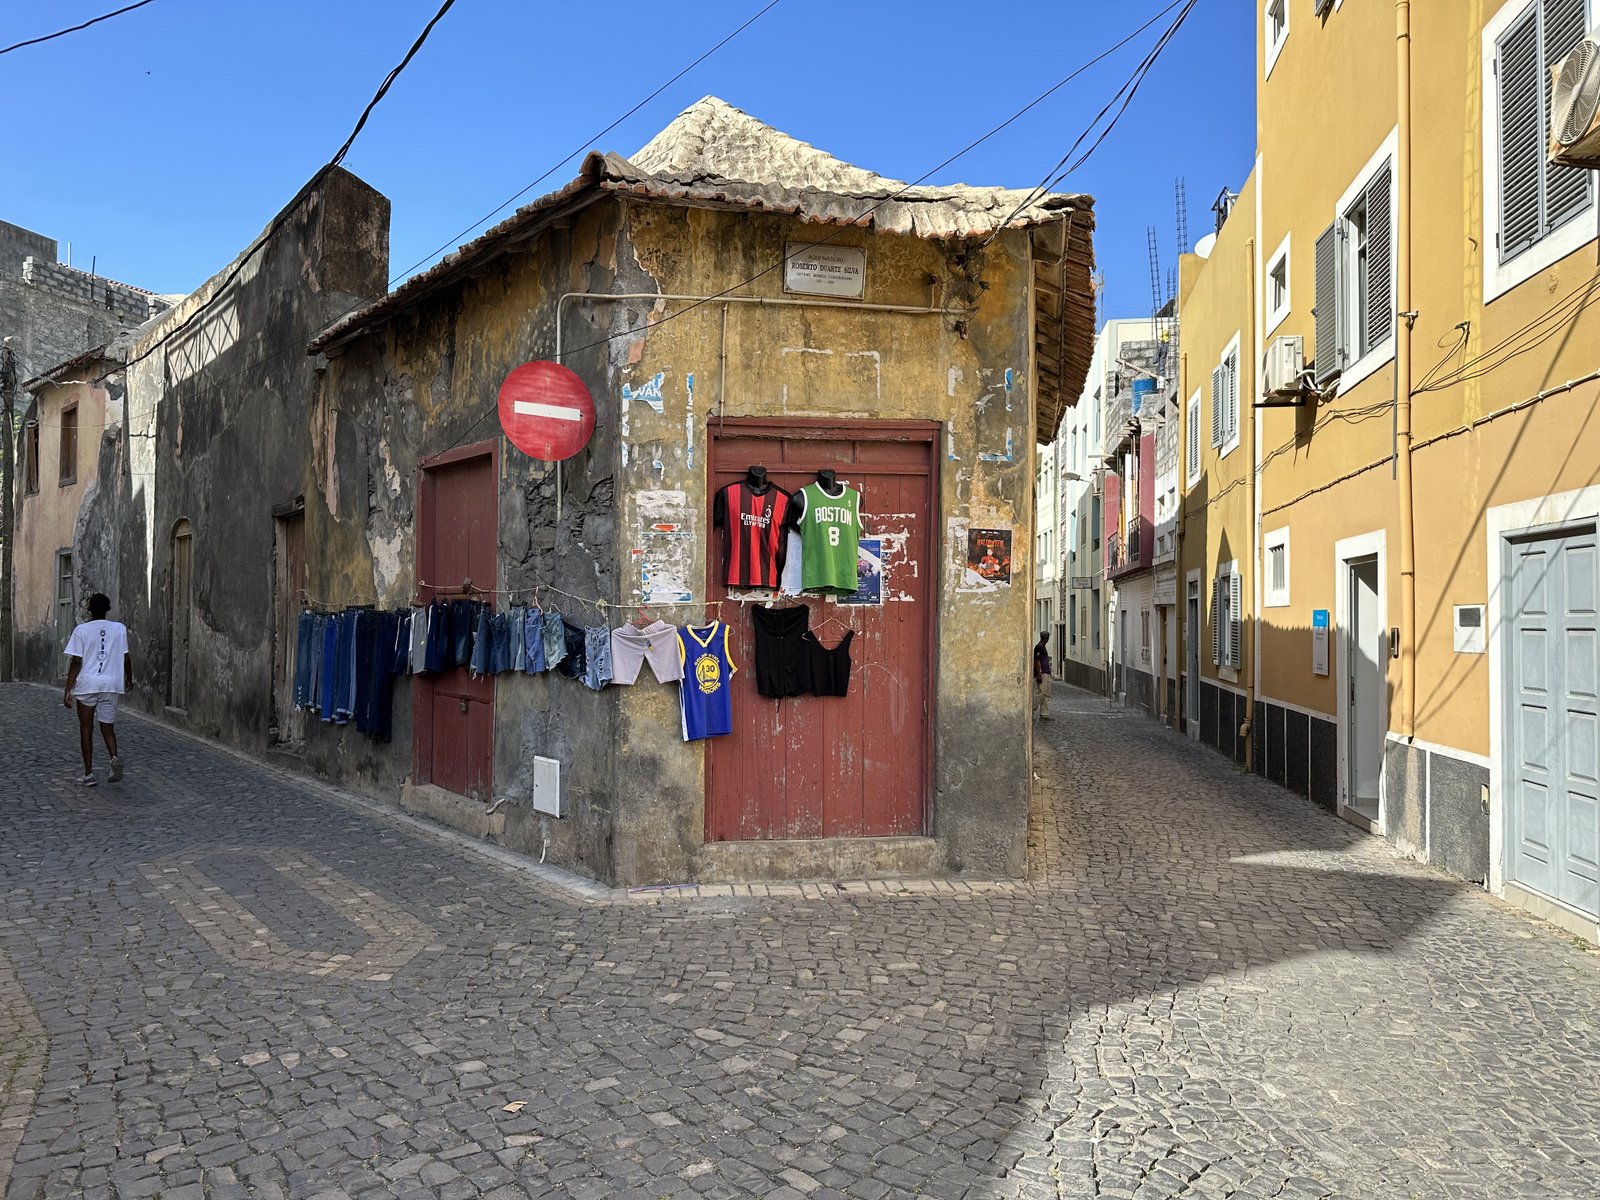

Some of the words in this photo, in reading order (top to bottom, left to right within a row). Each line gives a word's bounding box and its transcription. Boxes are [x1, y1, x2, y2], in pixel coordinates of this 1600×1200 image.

[791, 262, 818, 271] ROBERTO
[820, 264, 842, 273] DUARTE
[844, 266, 859, 275] SILVA
[741, 512, 770, 524] Emirates
[815, 506, 852, 526] BOSTON
[828, 526, 840, 546] 8
